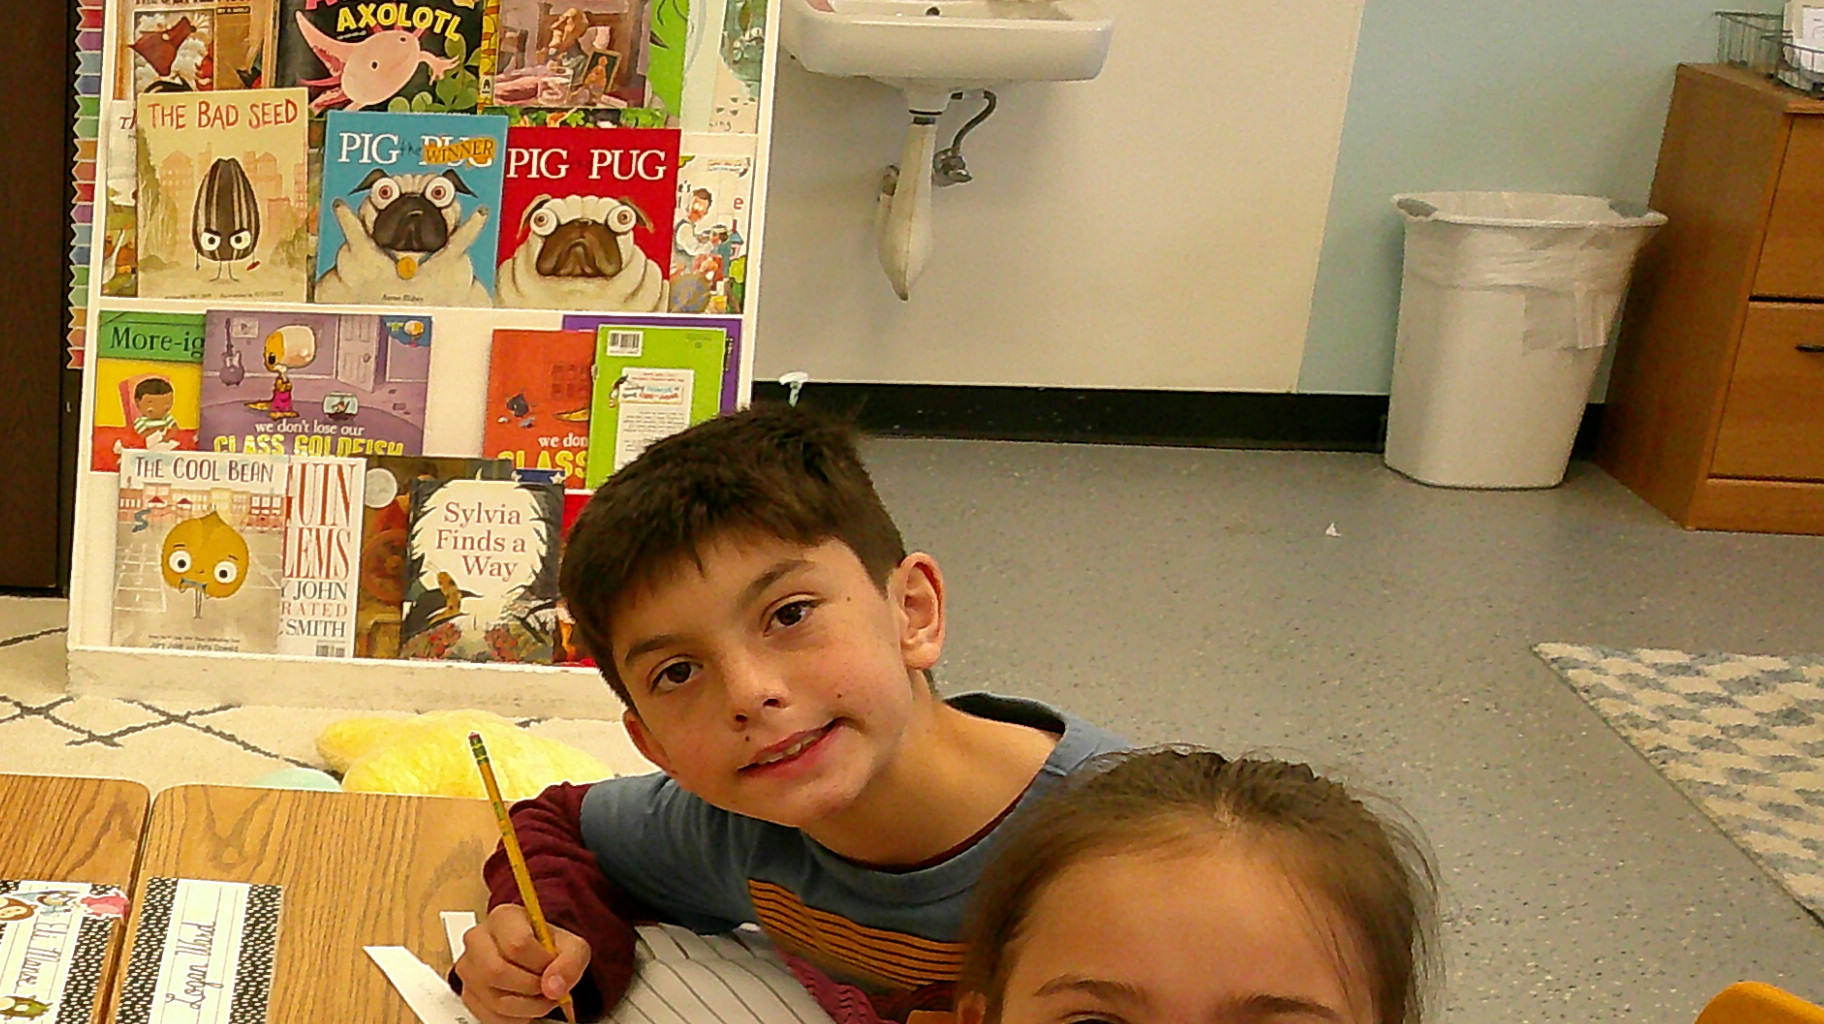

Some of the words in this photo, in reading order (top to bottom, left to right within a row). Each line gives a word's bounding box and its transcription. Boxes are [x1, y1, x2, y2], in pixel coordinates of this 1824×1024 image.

[336, 3, 462, 42] AXOLOTL
[147, 102, 187, 130] THE
[197, 100, 239, 130] BAD
[248, 99, 298, 129] SEED
[337, 132, 401, 165] PIG
[425, 138, 496, 163] WINNER
[506, 148, 570, 179] PIG
[588, 149, 667, 180] PUG
[255, 423, 274, 433] we
[277, 419, 309, 434] don't
[314, 420, 337, 434] lose
[341, 425, 364, 436] our
[538, 436, 560, 448] we
[136, 456, 164, 478] THE
[173, 457, 220, 482] COOL
[228, 459, 274, 483] BEAN
[444, 501, 521, 528] Sylvia
[436, 529, 506, 553] Finds
[512, 537, 526, 553] a
[462, 555, 518, 582] Way
[293, 580, 348, 600] JOHN
[286, 618, 346, 637] SMITH
[175, 921, 216, 956] Ward
[165, 963, 225, 1010] Logan
